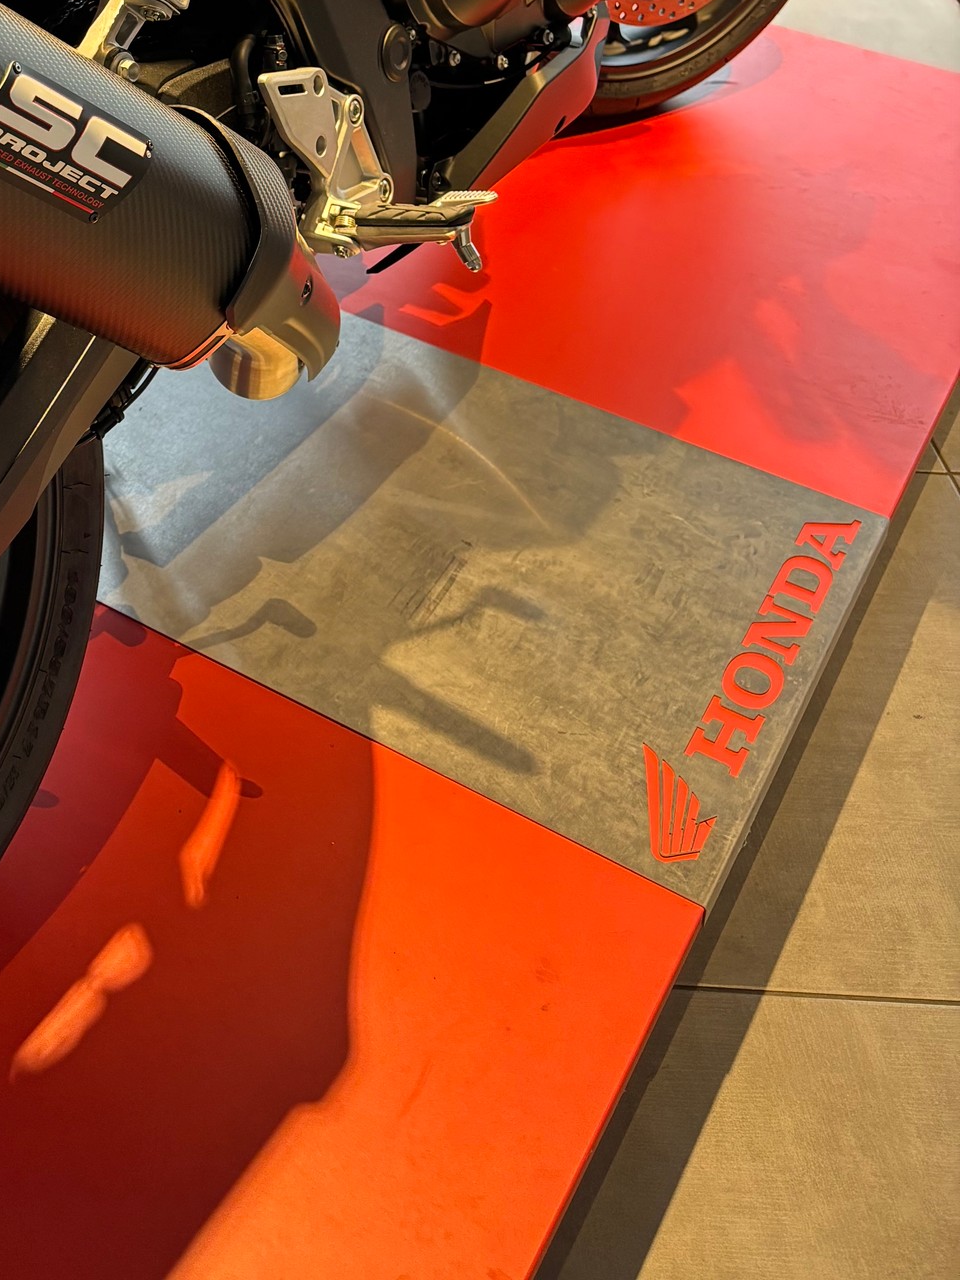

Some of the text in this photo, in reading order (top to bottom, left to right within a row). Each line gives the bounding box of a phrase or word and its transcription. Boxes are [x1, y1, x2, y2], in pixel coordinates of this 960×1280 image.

[14, 158, 52, 183] EXHAUST
[51, 176, 105, 210] TECHNOLOGY
[683, 519, 863, 780] HONDA
